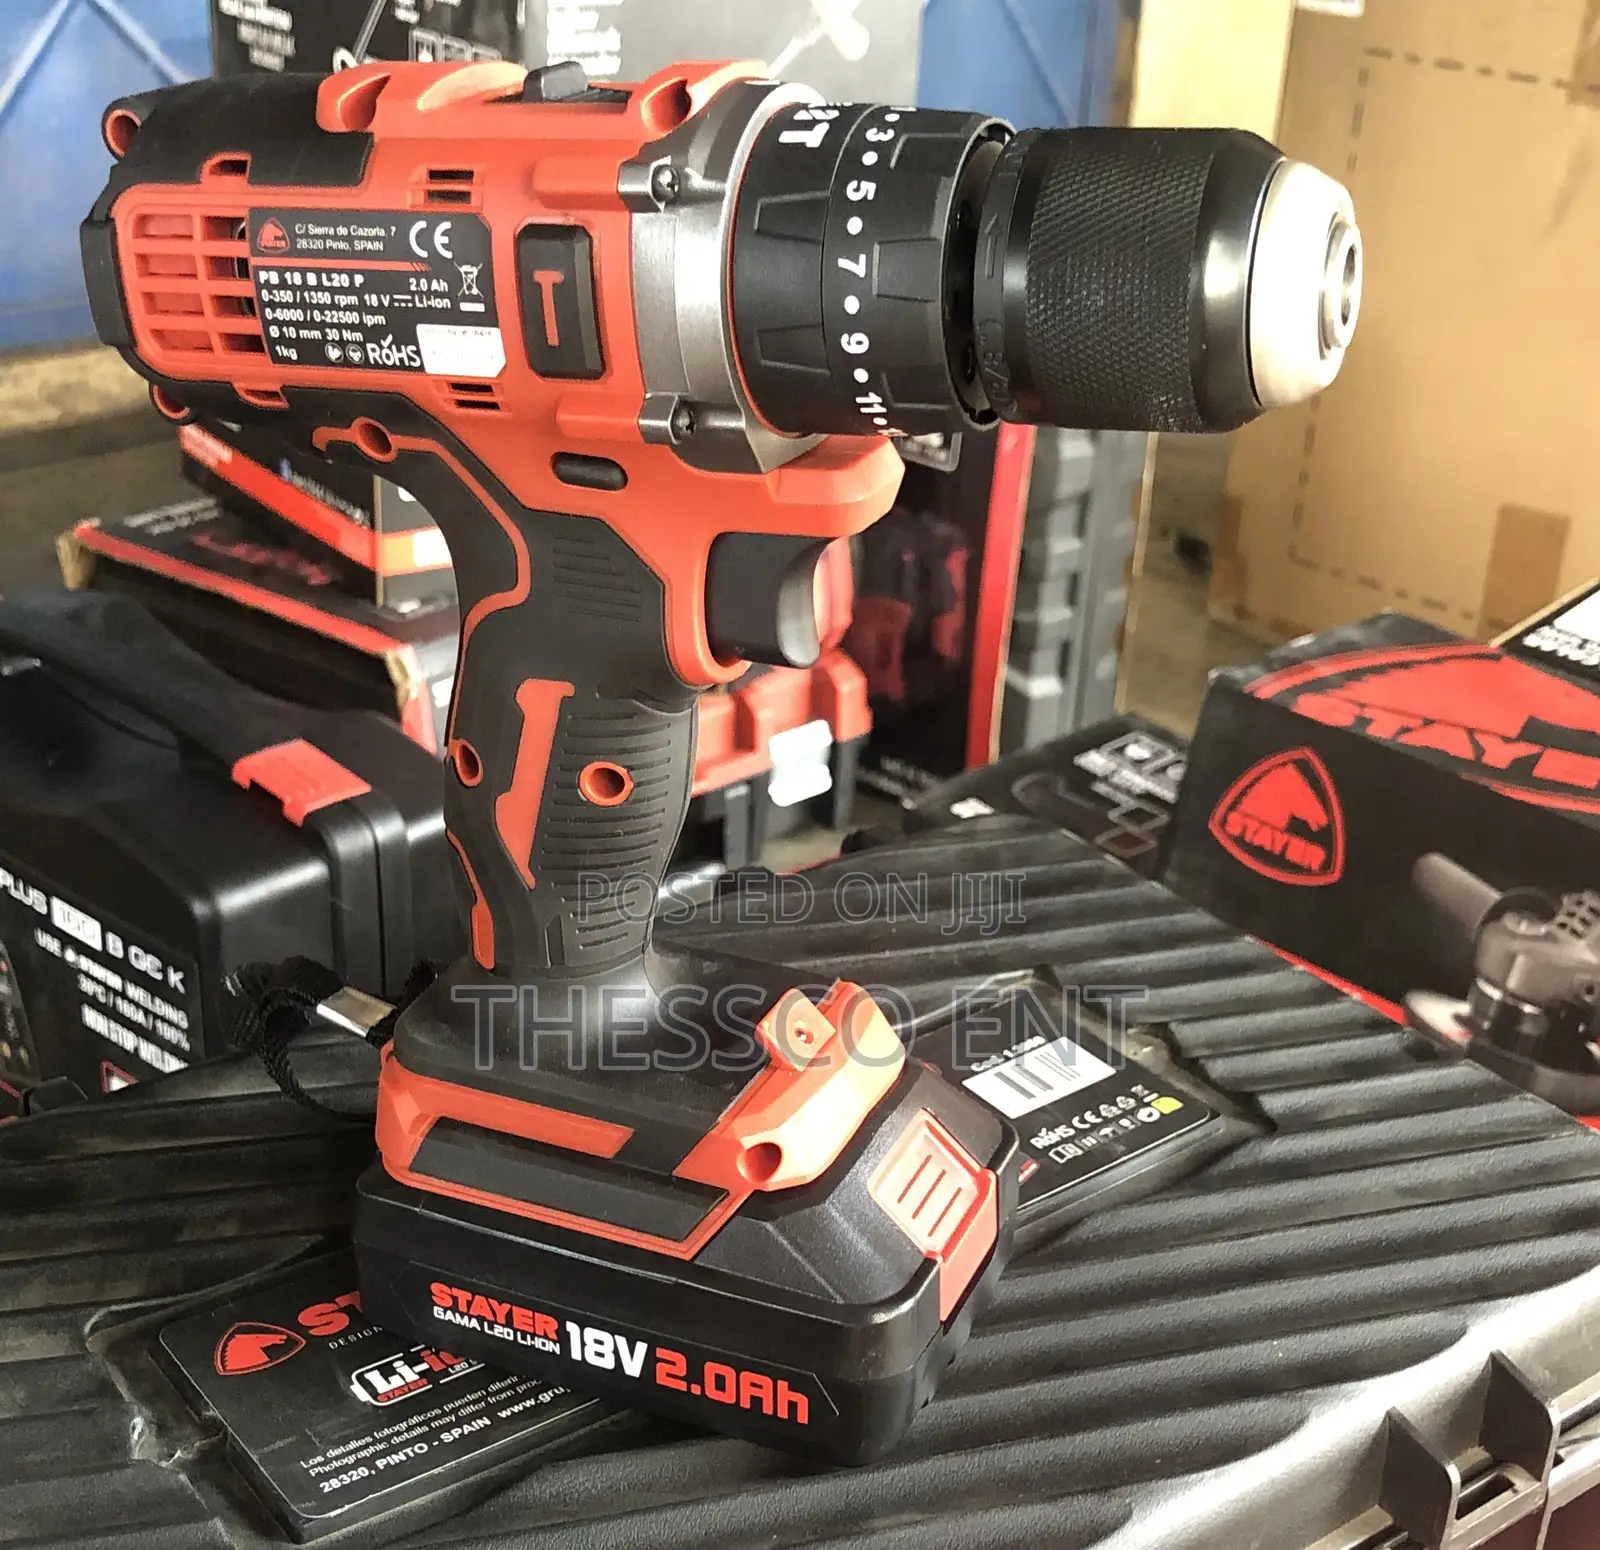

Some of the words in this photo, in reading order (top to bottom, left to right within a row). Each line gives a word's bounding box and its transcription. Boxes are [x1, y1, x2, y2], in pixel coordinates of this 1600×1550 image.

[865, 127, 895, 142] 3
[846, 180, 877, 201] 5
[308, 224, 335, 236] Sierra
[337, 225, 349, 236] de
[296, 238, 324, 250] 28320
[326, 239, 352, 251] Pinto,
[354, 240, 384, 251] SPAIN
[837, 253, 867, 278] 7
[258, 270, 278, 285] PB
[284, 271, 302, 286] 18
[322, 273, 349, 287] L20
[354, 273, 364, 288] P
[409, 277, 428, 292] 2.0
[430, 278, 448, 293] Ah
[261, 290, 293, 303] 0-350
[303, 291, 332, 305] 1350
[334, 294, 358, 307] rpm
[364, 293, 378, 306] 18
[380, 294, 390, 307] V
[265, 307, 304, 322] 0-6000
[313, 310, 359, 326] 0-22500
[363, 312, 386, 327] ipm
[282, 326, 296, 340] 10
[300, 329, 322, 341] mm
[326, 328, 339, 342] 30
[342, 328, 363, 343] Nm
[840, 332, 870, 354] 9
[275, 345, 298, 361] 1kg
[855, 391, 888, 414] 11
[1226, 811, 1326, 871] STAYER
[167, 965, 186, 995] K
[124, 979, 189, 1030] WELDING
[430, 1282, 558, 1340] STAYER
[433, 1305, 481, 1332] GAMA
[483, 1320, 514, 1342] L20
[517, 1329, 560, 1355] LI-ION
[566, 1321, 648, 1378] 18V
[655, 1347, 809, 1425] 2.0Ah
[300, 1456, 325, 1468] Los
[326, 1436, 373, 1459] detalles
[373, 1408, 442, 1440] fotográficos
[443, 1388, 487, 1413] pueden
[488, 1375, 519, 1393] diferir
[309, 1441, 390, 1477] Photographic
[391, 1426, 430, 1444] details
[431, 1413, 456, 1430] may
[458, 1401, 486, 1417] differ
[487, 1389, 515, 1405] from
[319, 1466, 376, 1493] 28320,
[375, 1443, 429, 1470] PINTO
[440, 1416, 492, 1443] SPAIN
[497, 1385, 571, 1419] www.gru
